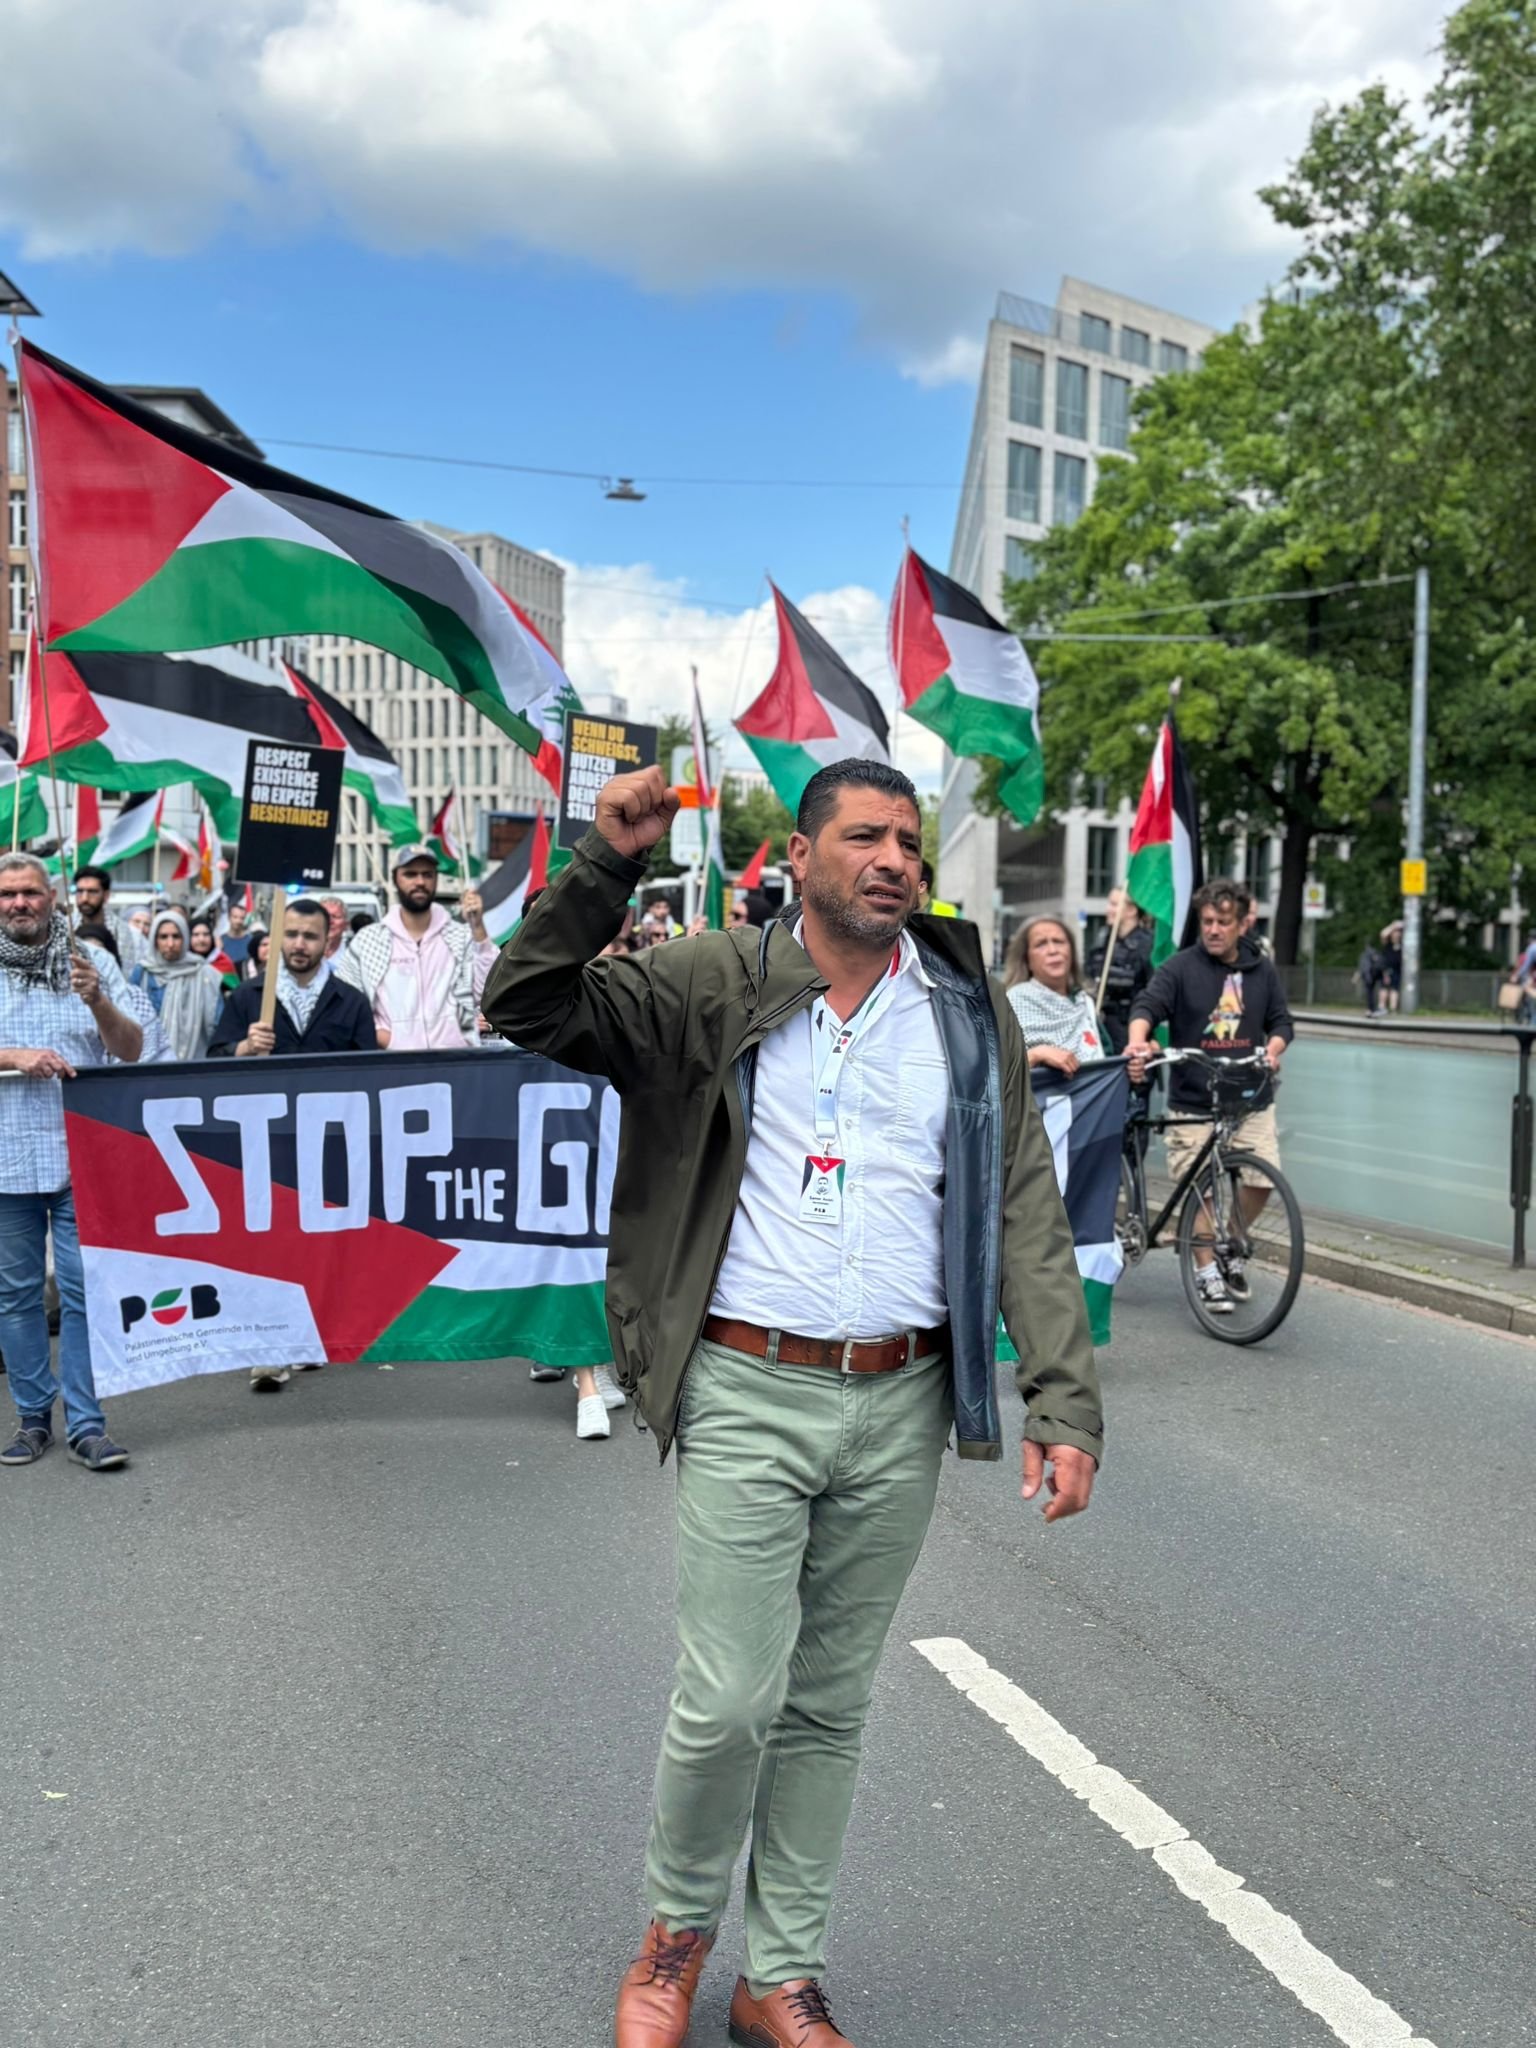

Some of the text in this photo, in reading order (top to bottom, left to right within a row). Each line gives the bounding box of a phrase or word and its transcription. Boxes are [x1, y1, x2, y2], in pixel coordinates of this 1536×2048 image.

[572, 717, 626, 743] WENN DU
[254, 746, 311, 770] RESPECT
[571, 735, 641, 765] SCHWEIGST,
[570, 752, 616, 775] NUTZEN
[252, 765, 320, 790] EXISTENCE
[569, 768, 614, 790] ANDER
[251, 784, 319, 809] OR EXPECT
[567, 784, 602, 805] DEIN
[248, 803, 330, 829] RESISTANCE!
[142, 1081, 453, 1237] STOP
[426, 1167, 506, 1224] THE
[195, 1324, 242, 1339] Gemeinde
[243, 1322, 253, 1333] in
[254, 1322, 289, 1332] Bremen
[125, 1353, 143, 1365] und
[143, 1344, 192, 1361] Umgebung
